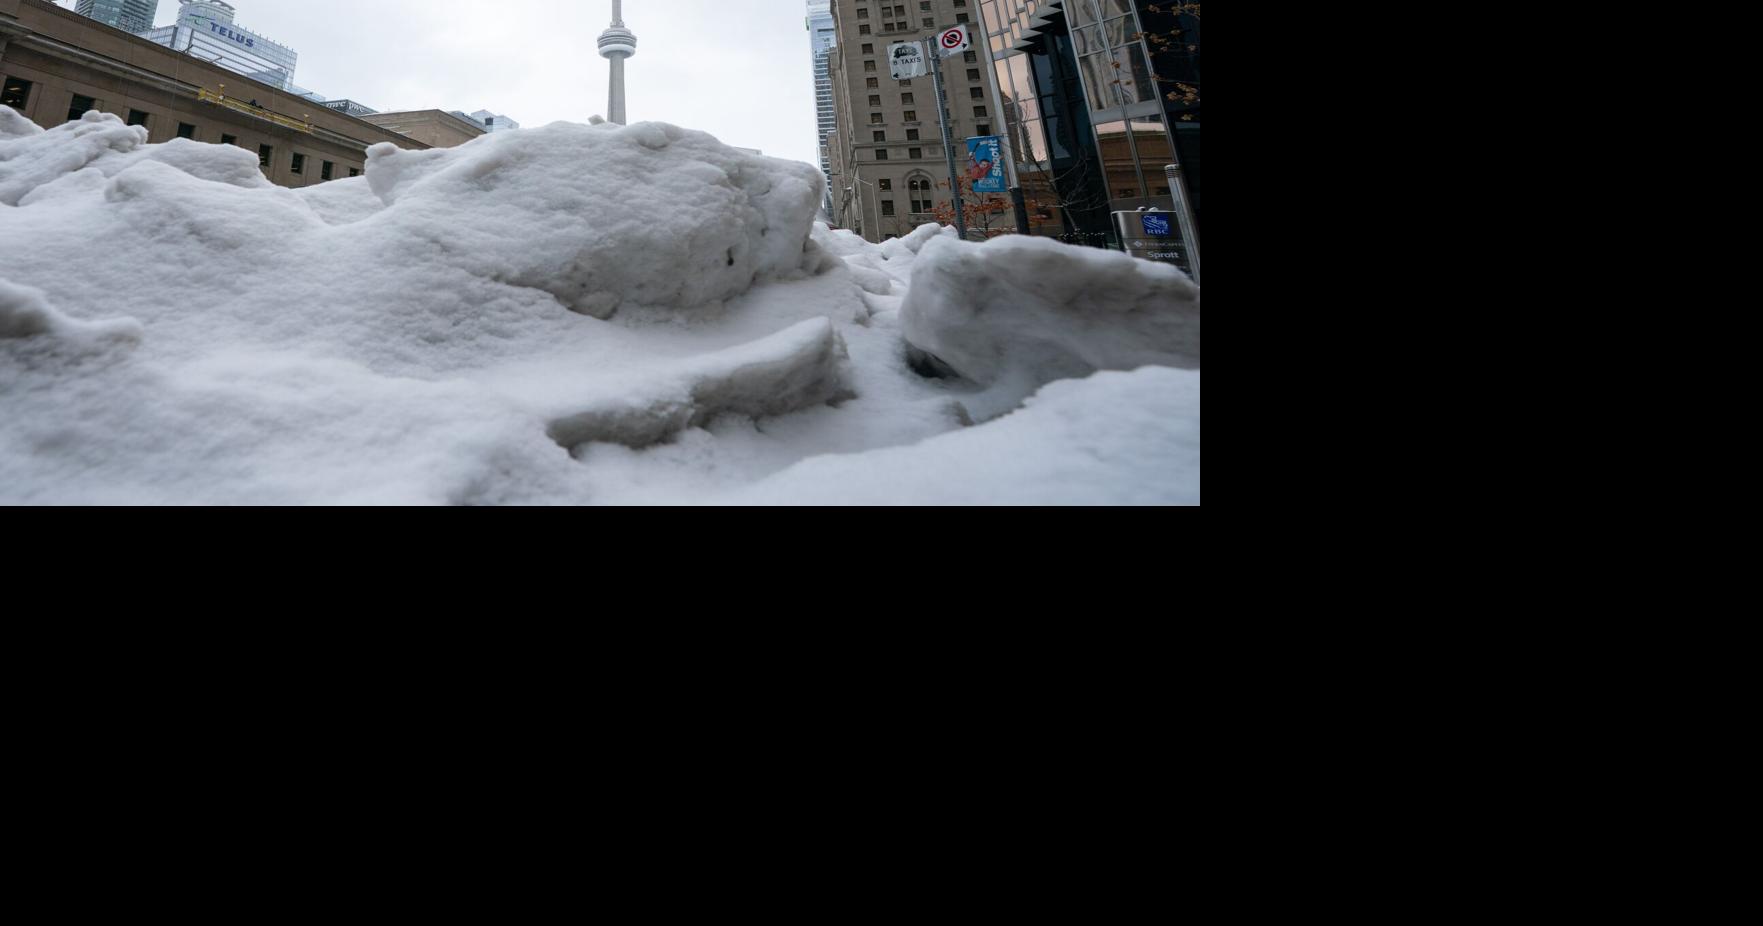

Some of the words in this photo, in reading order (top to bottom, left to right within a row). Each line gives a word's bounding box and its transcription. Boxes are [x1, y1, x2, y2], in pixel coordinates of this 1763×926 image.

[210, 22, 254, 47] TELUS
[901, 57, 921, 65] TAXIS
[989, 147, 1001, 176] Shoot
[1147, 251, 1179, 259] Sprott
